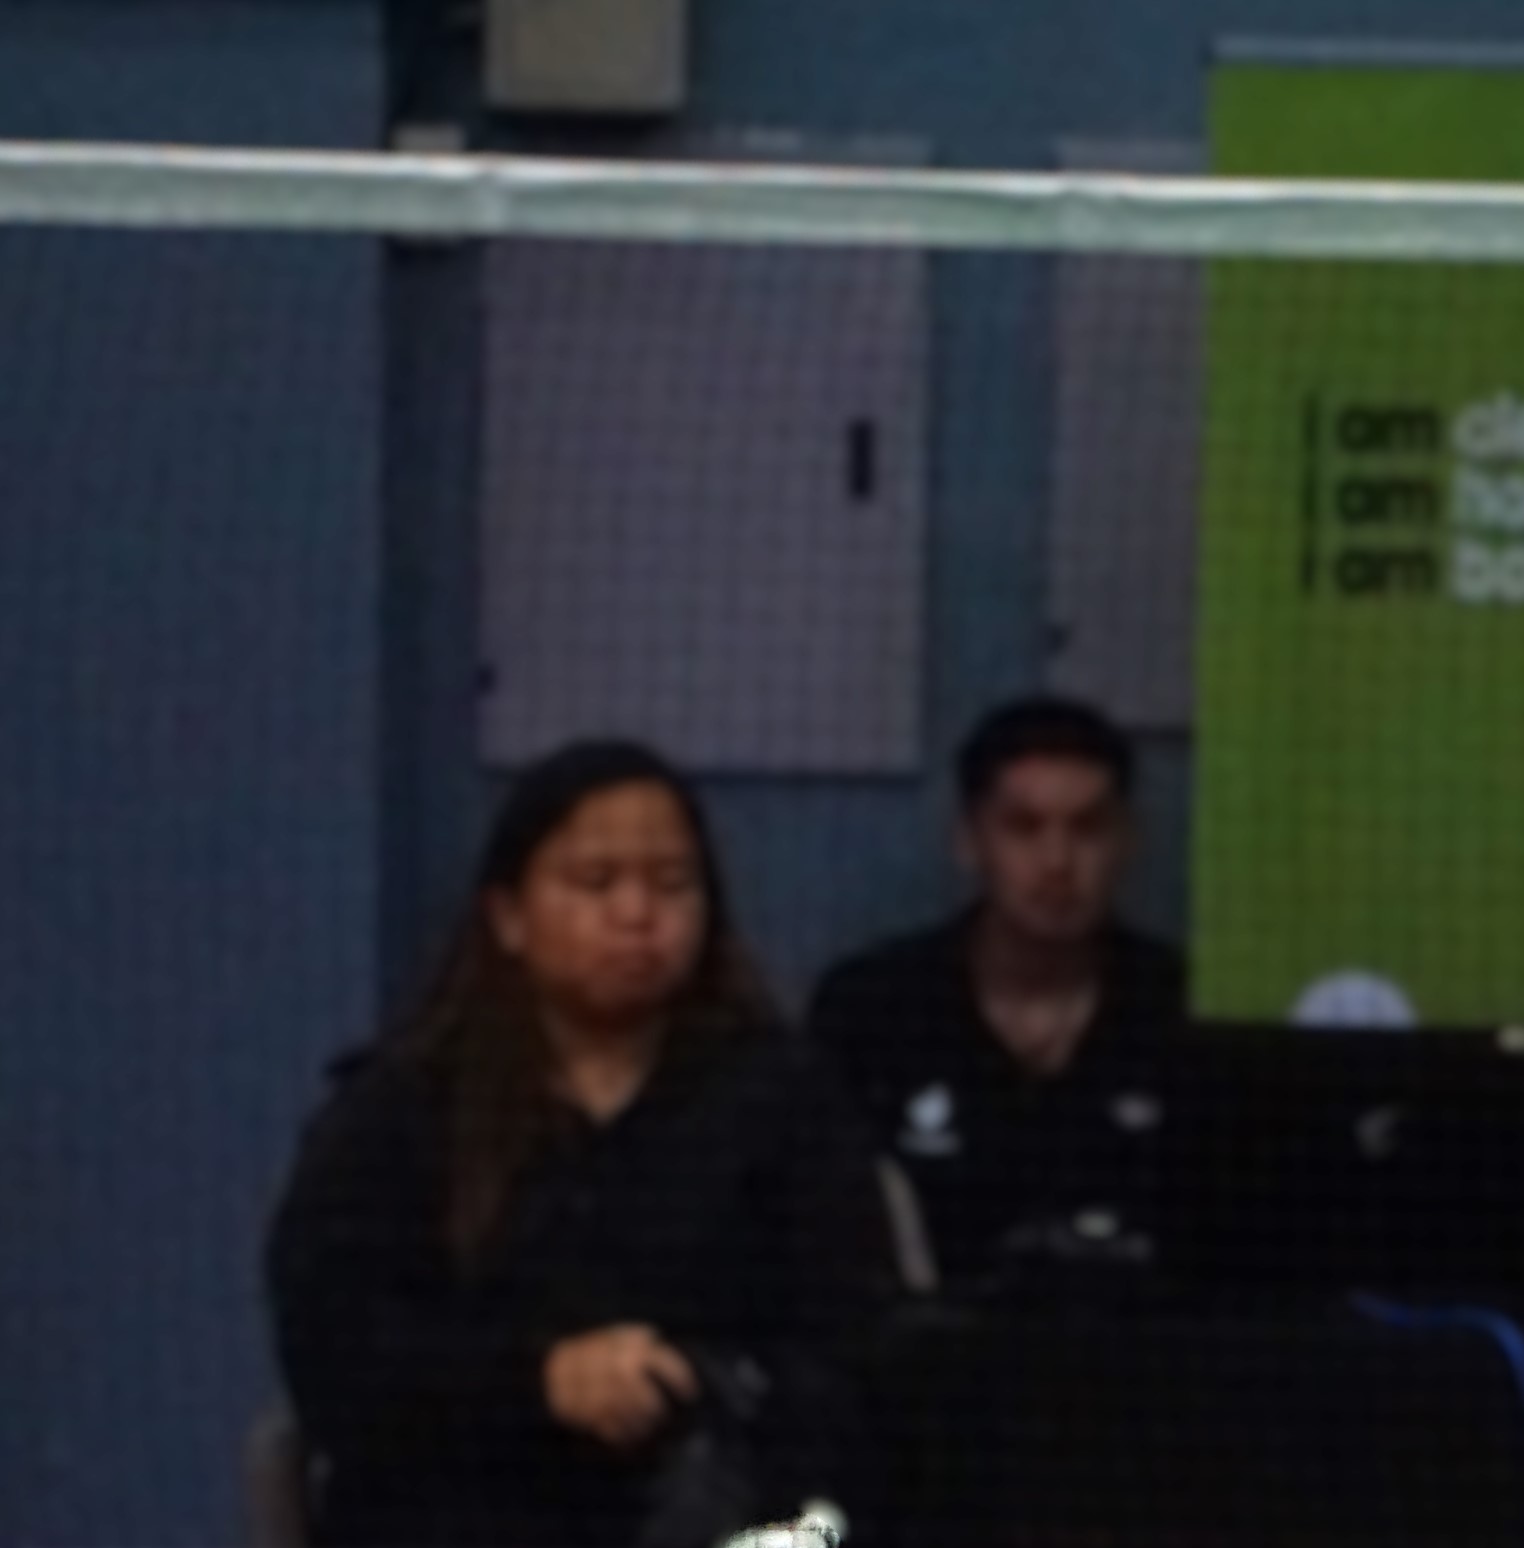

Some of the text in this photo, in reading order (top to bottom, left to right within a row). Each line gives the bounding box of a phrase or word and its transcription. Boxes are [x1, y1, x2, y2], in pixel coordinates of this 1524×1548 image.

[1337, 404, 1440, 455] am
[1337, 475, 1438, 527] am
[1336, 546, 1438, 597] am
